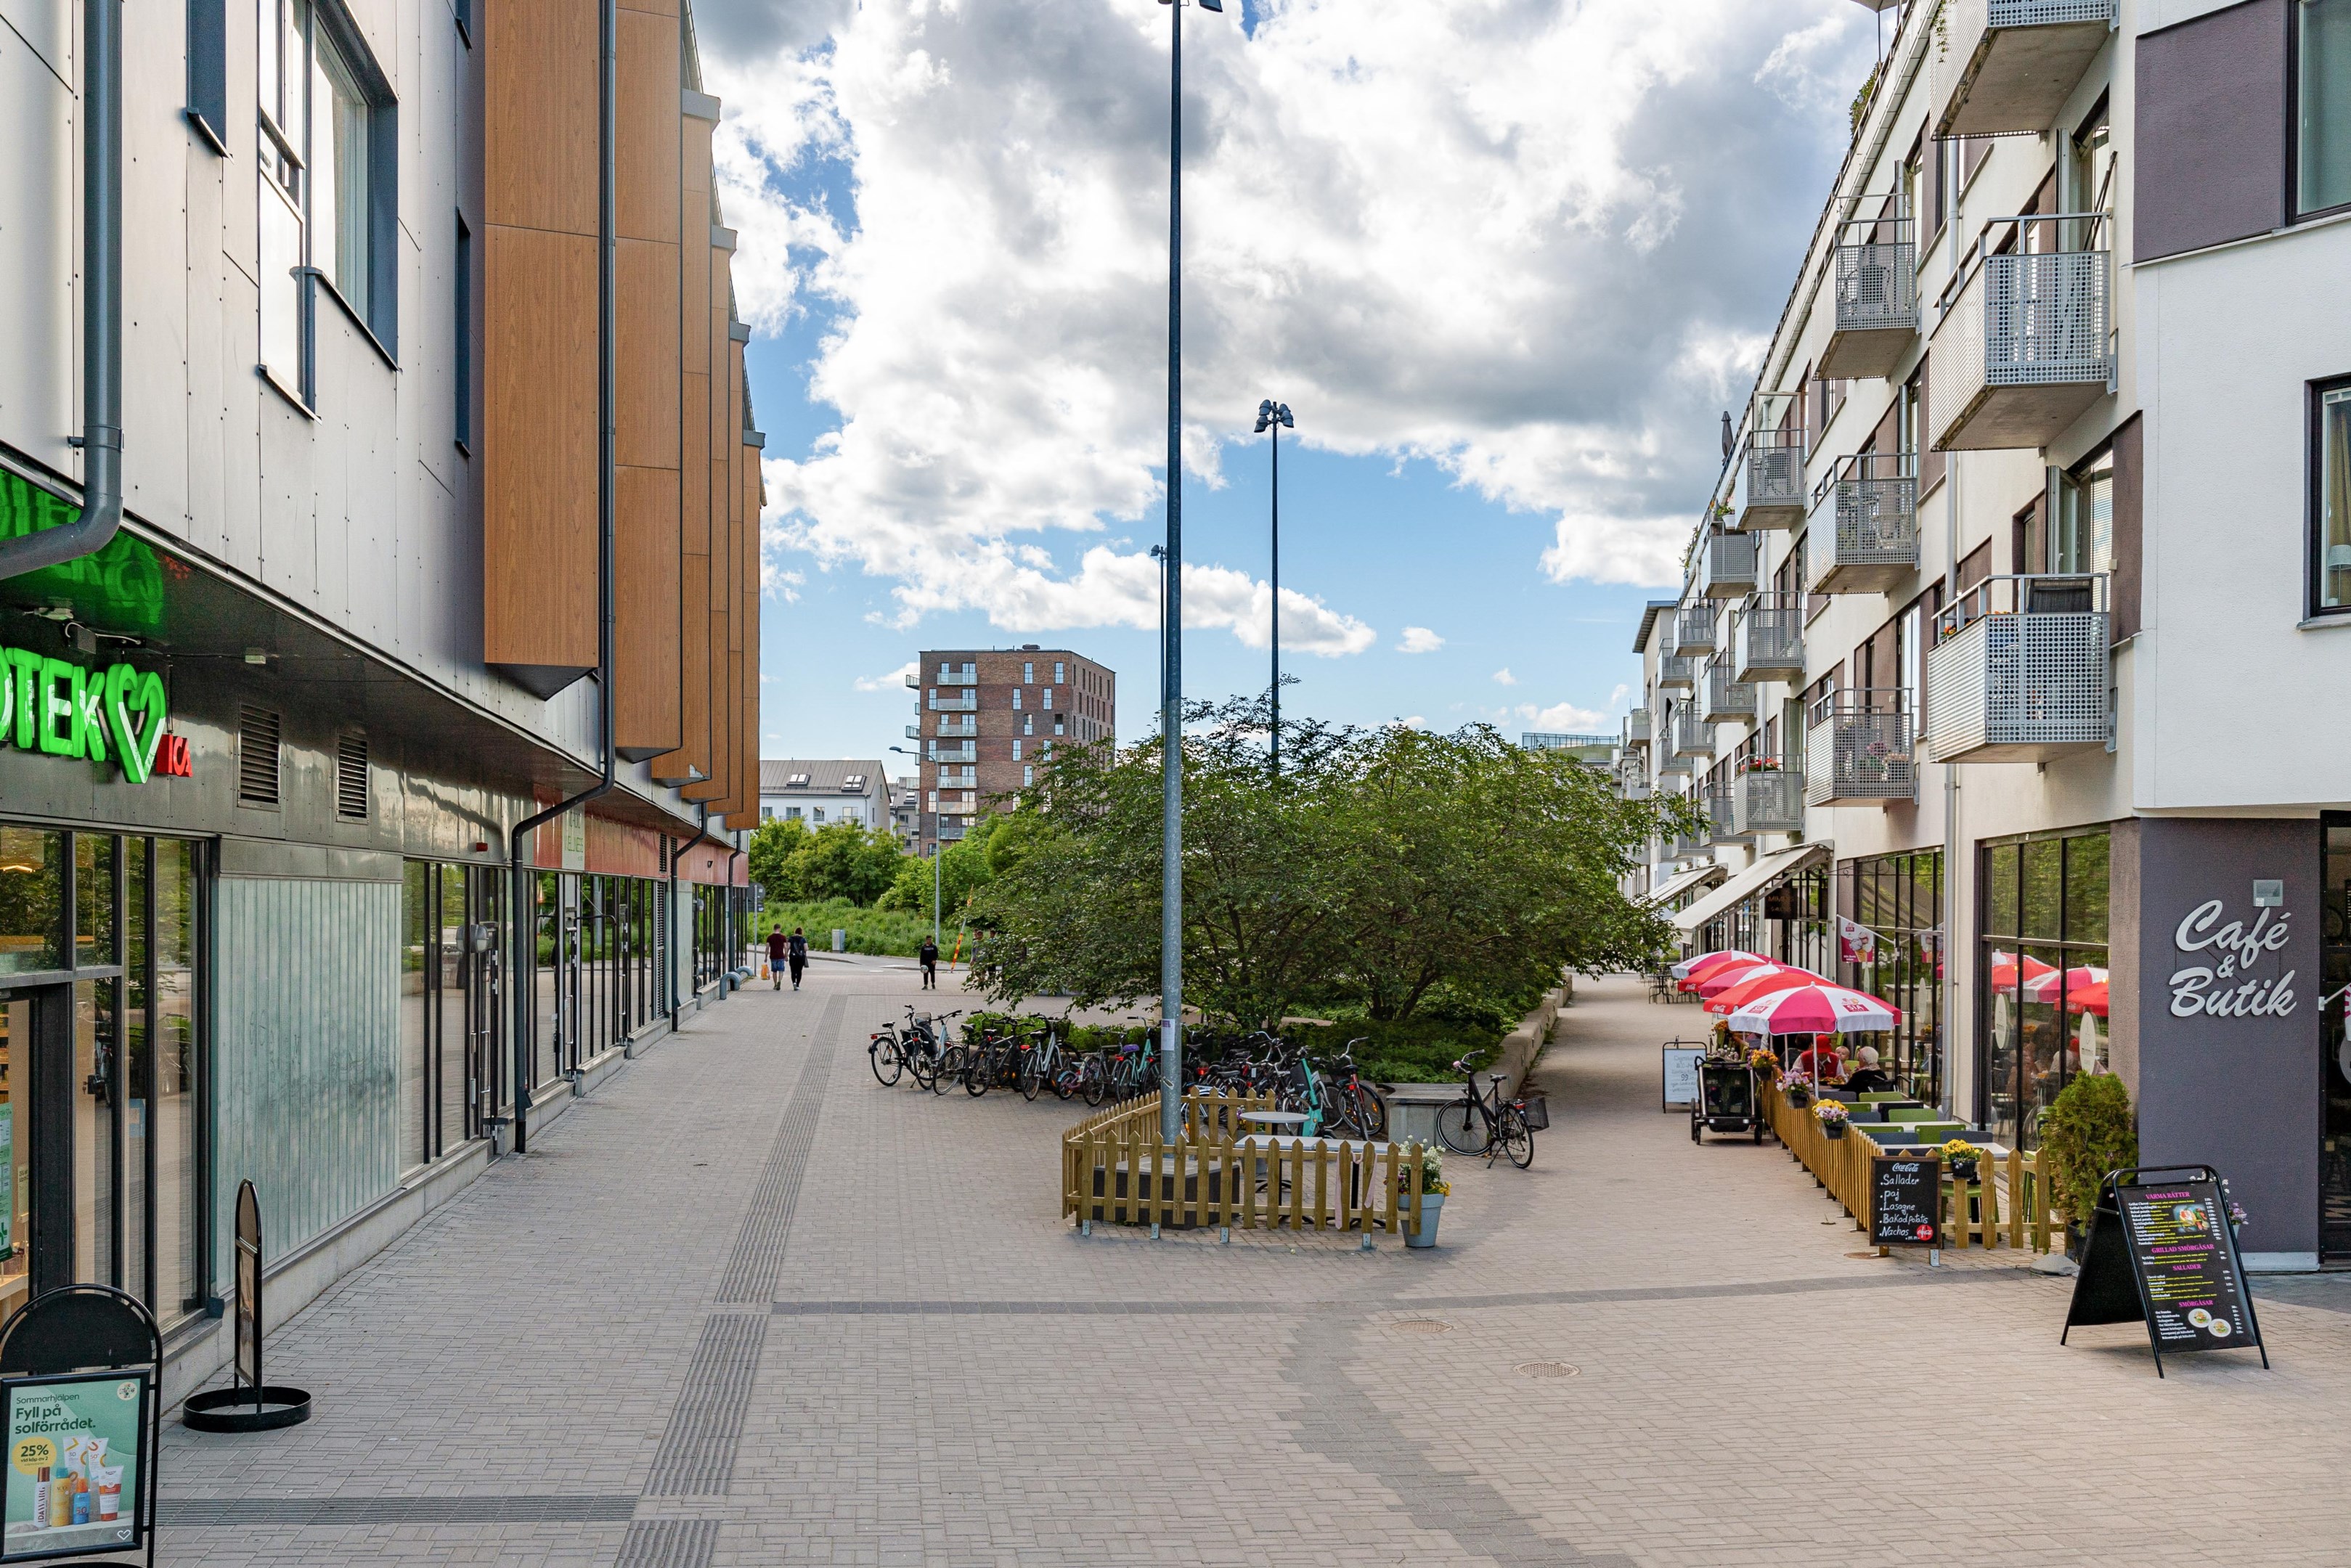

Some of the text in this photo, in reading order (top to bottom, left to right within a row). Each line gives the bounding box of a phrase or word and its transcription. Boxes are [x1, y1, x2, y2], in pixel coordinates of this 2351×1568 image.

[158, 733, 193, 777] ICA
[2175, 899, 2291, 969] Café
[2217, 955, 2236, 979] &
[2169, 967, 2297, 1017] Butik
[1883, 1202, 1915, 1215] Lasagne
[1881, 1225, 1910, 1236] Nachos
[2177, 1244, 2214, 1252] SMÖRGÅSAR
[16, 1393, 80, 1405] Sommarhjälpen
[16, 1403, 62, 1421] Fyll på
[15, 1417, 96, 1434] solförrådet.
[21, 1444, 49, 1458] 25%
